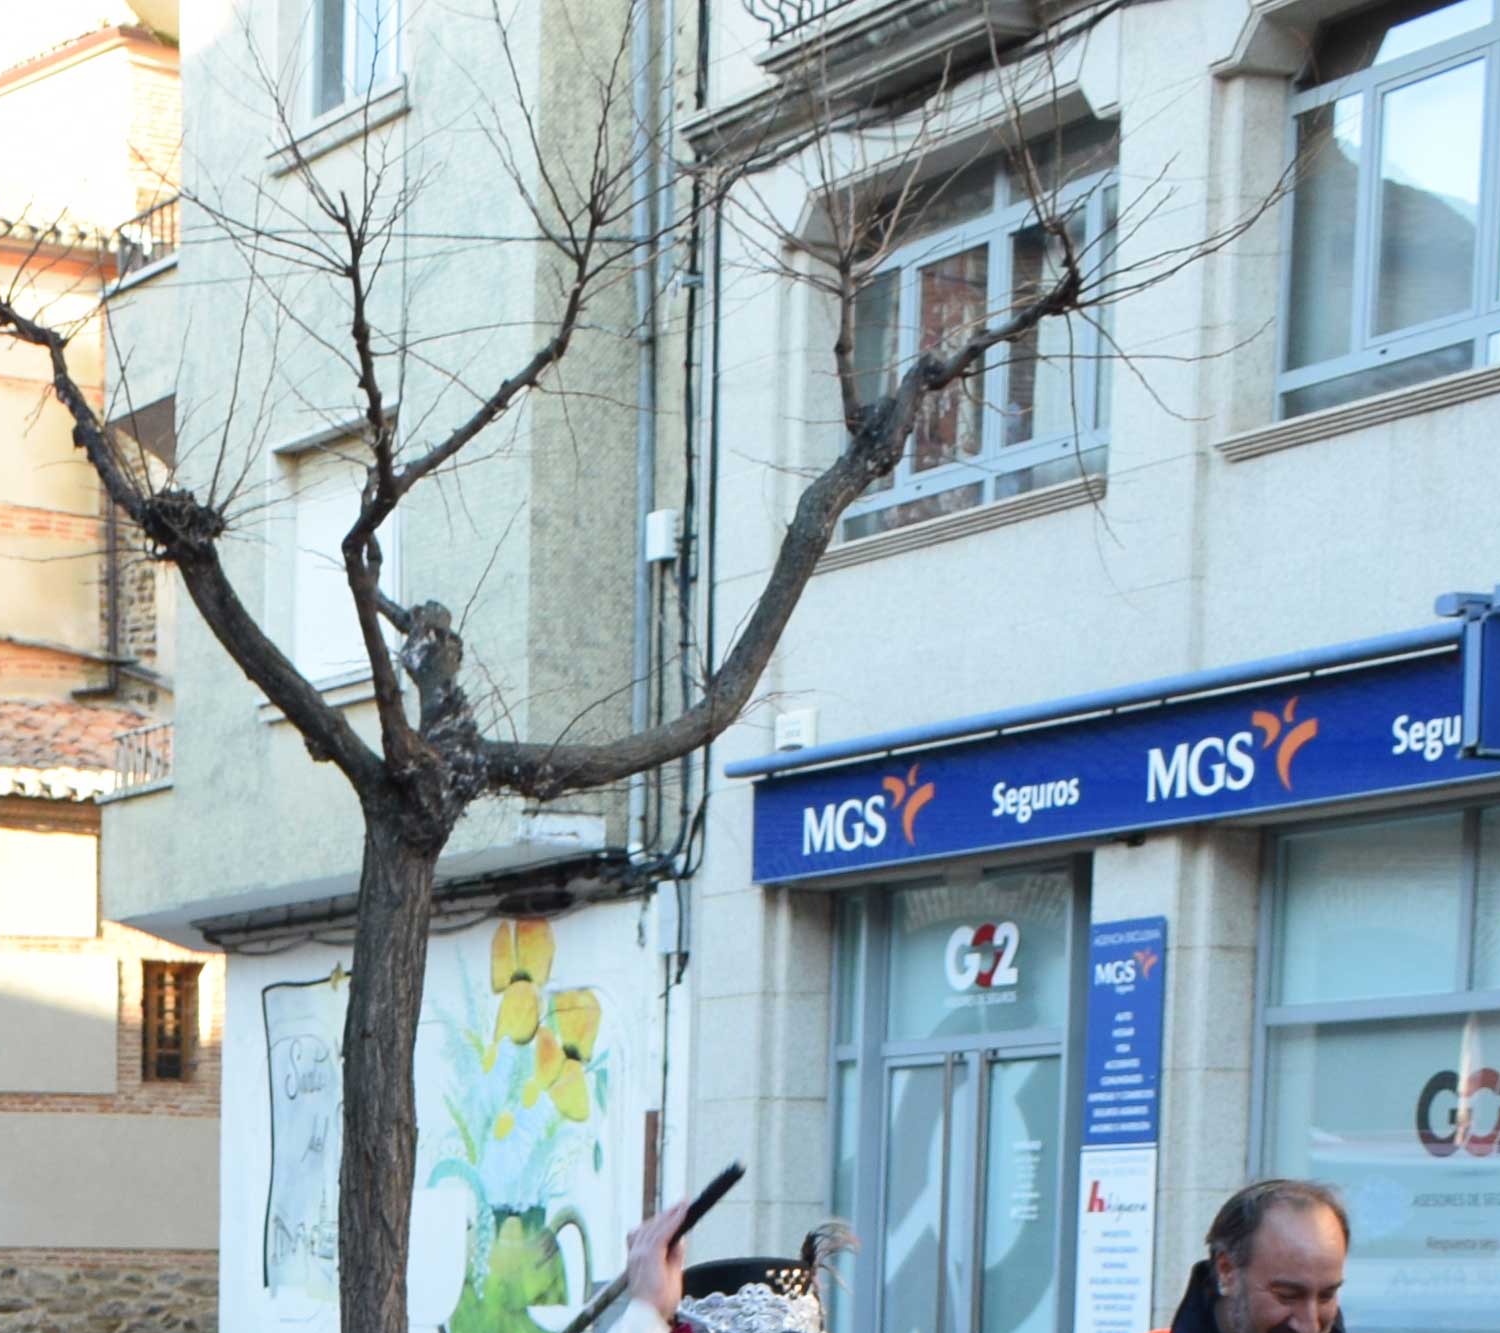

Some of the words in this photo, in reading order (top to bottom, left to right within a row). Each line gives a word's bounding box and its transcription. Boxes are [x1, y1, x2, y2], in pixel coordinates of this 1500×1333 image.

[1146, 731, 1255, 803] MGS
[802, 794, 887, 855] MGS
[991, 777, 1080, 823] Seguros
[1094, 959, 1136, 986] MGS
